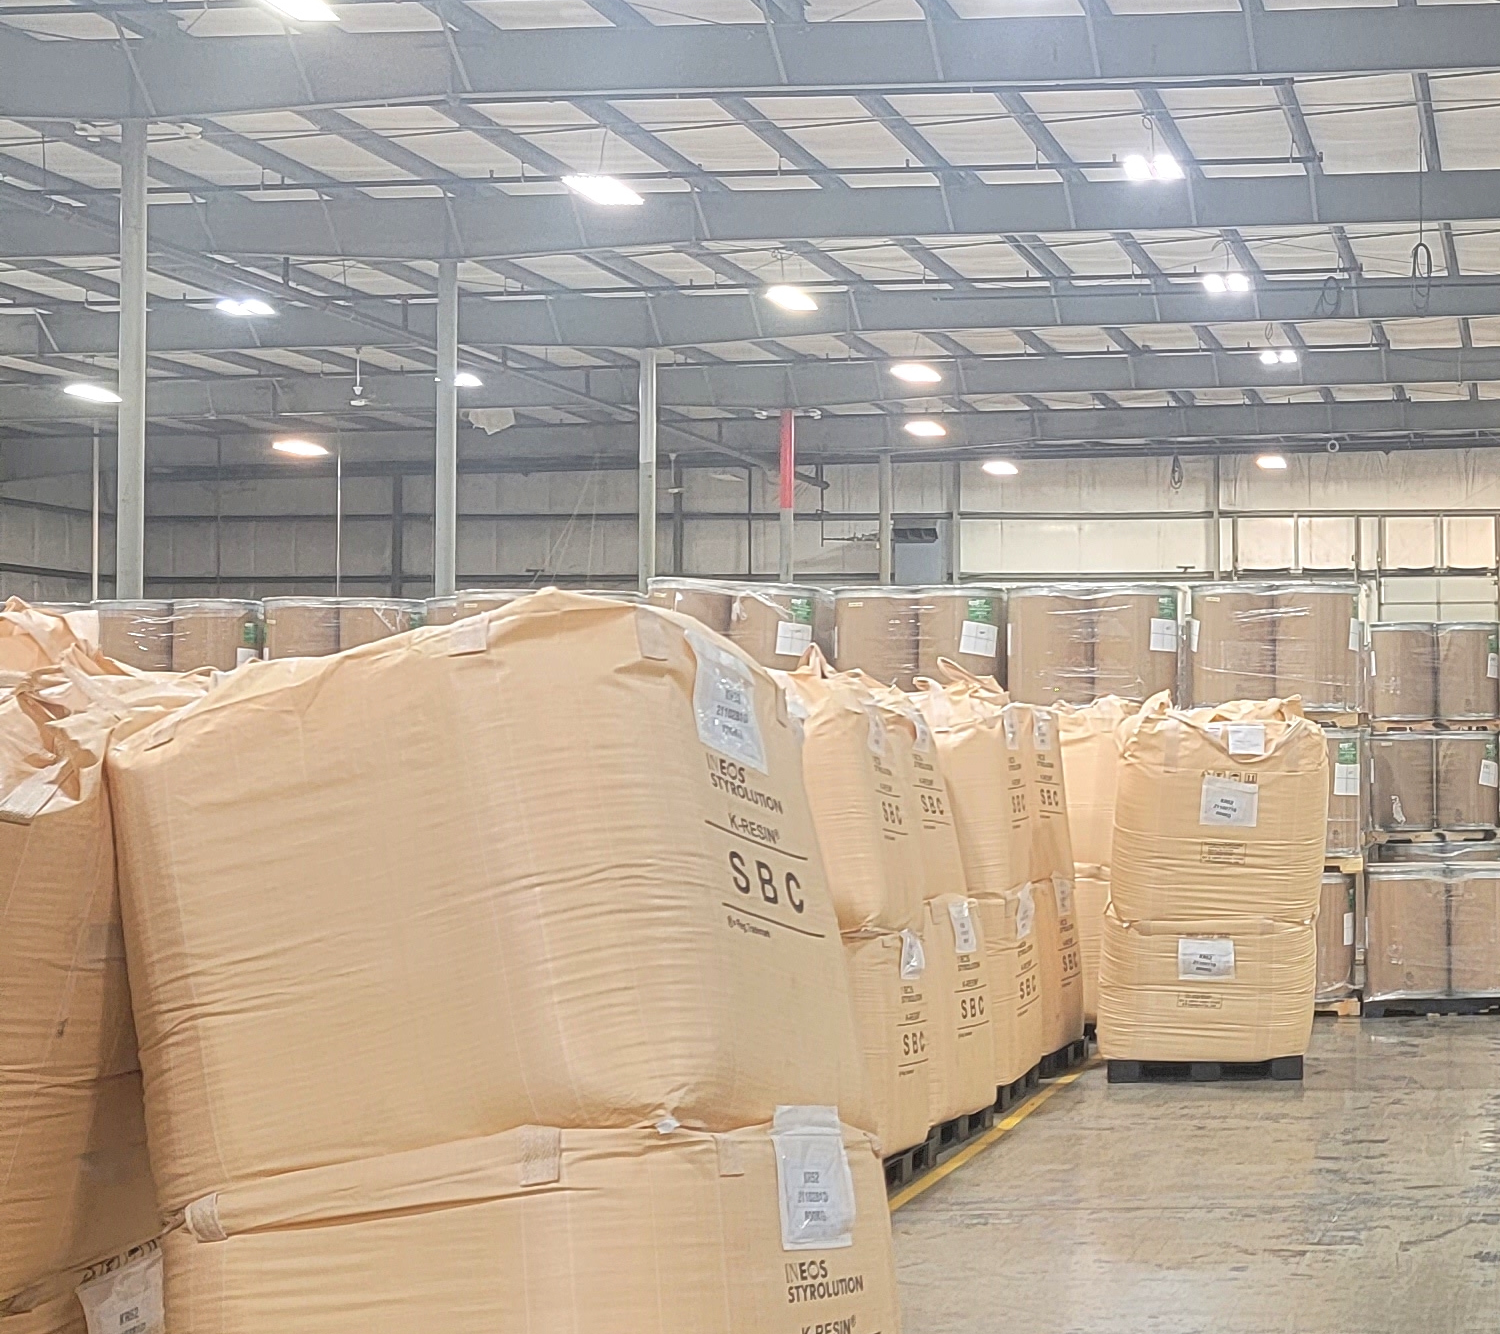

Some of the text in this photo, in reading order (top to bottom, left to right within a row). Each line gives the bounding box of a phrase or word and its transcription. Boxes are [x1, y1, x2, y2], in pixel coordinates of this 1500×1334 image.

[706, 752, 746, 784] INEOS
[710, 772, 783, 814] STYROLUTION
[920, 794, 944, 815] SBC
[728, 850, 804, 914] SBC
[960, 995, 985, 1019] SBC
[903, 1030, 926, 1056] SBC
[784, 1259, 828, 1283] INEOS
[788, 1275, 864, 1303] STYROLUTION
